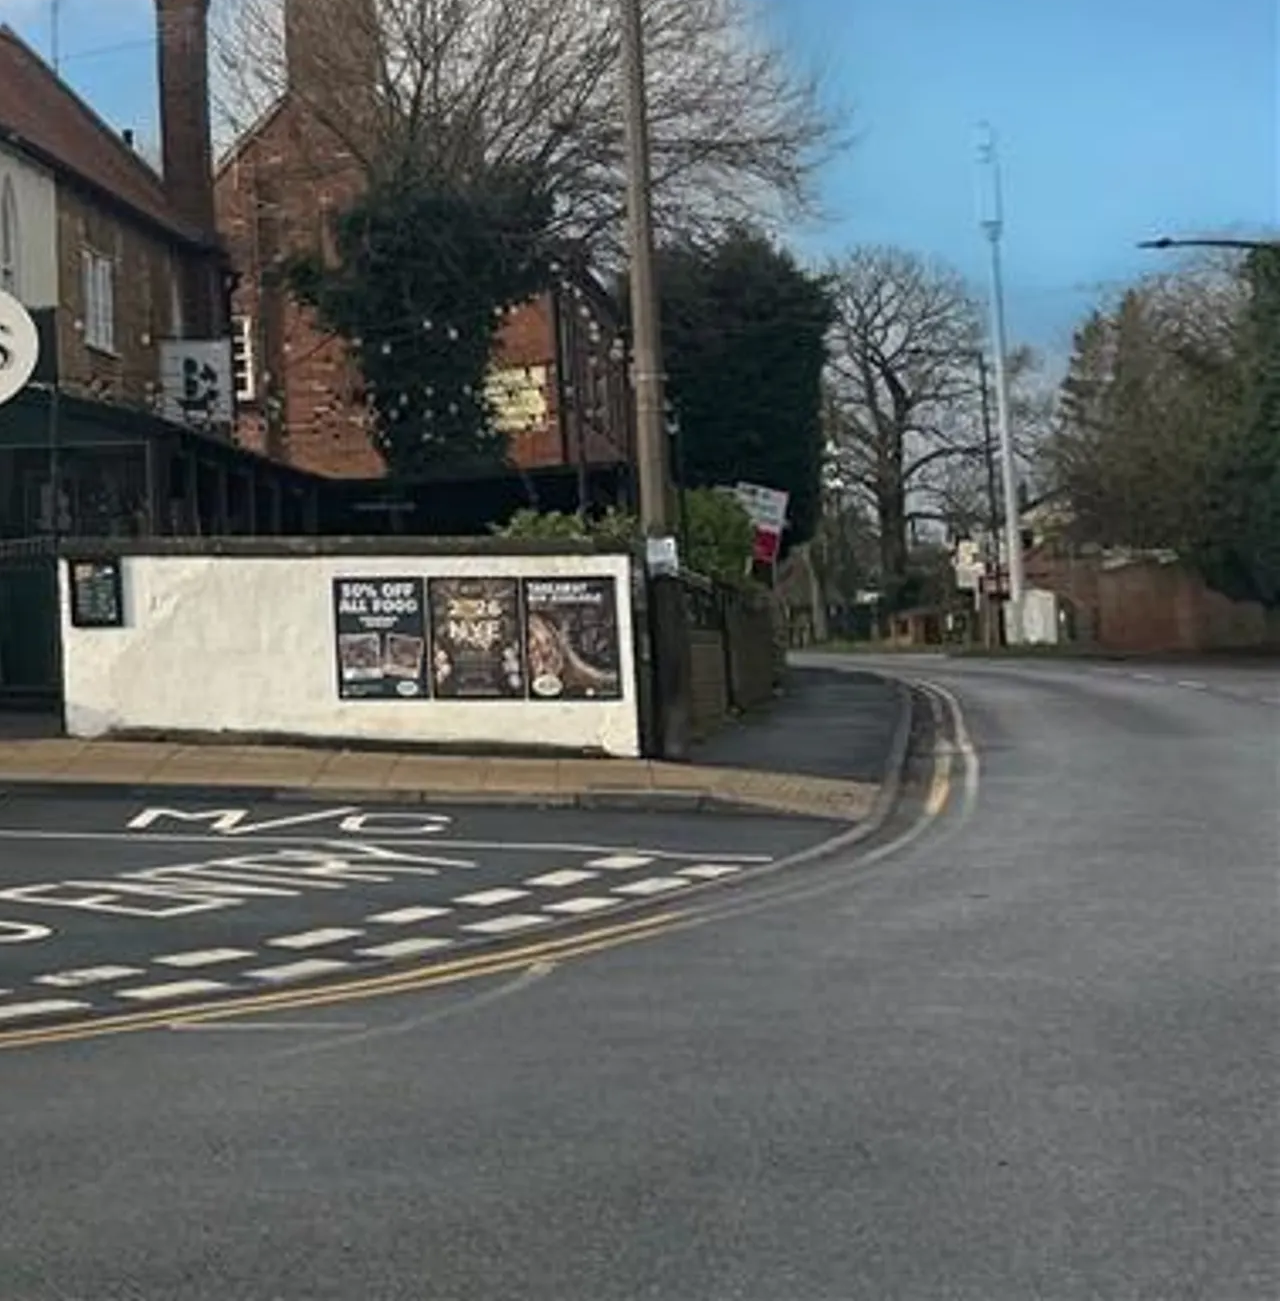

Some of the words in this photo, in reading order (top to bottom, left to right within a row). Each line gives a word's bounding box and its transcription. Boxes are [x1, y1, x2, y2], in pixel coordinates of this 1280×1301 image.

[382, 582, 414, 598] OFF
[339, 599, 368, 614] ALL
[373, 599, 418, 614] FOOD
[449, 620, 501, 640] NYE
